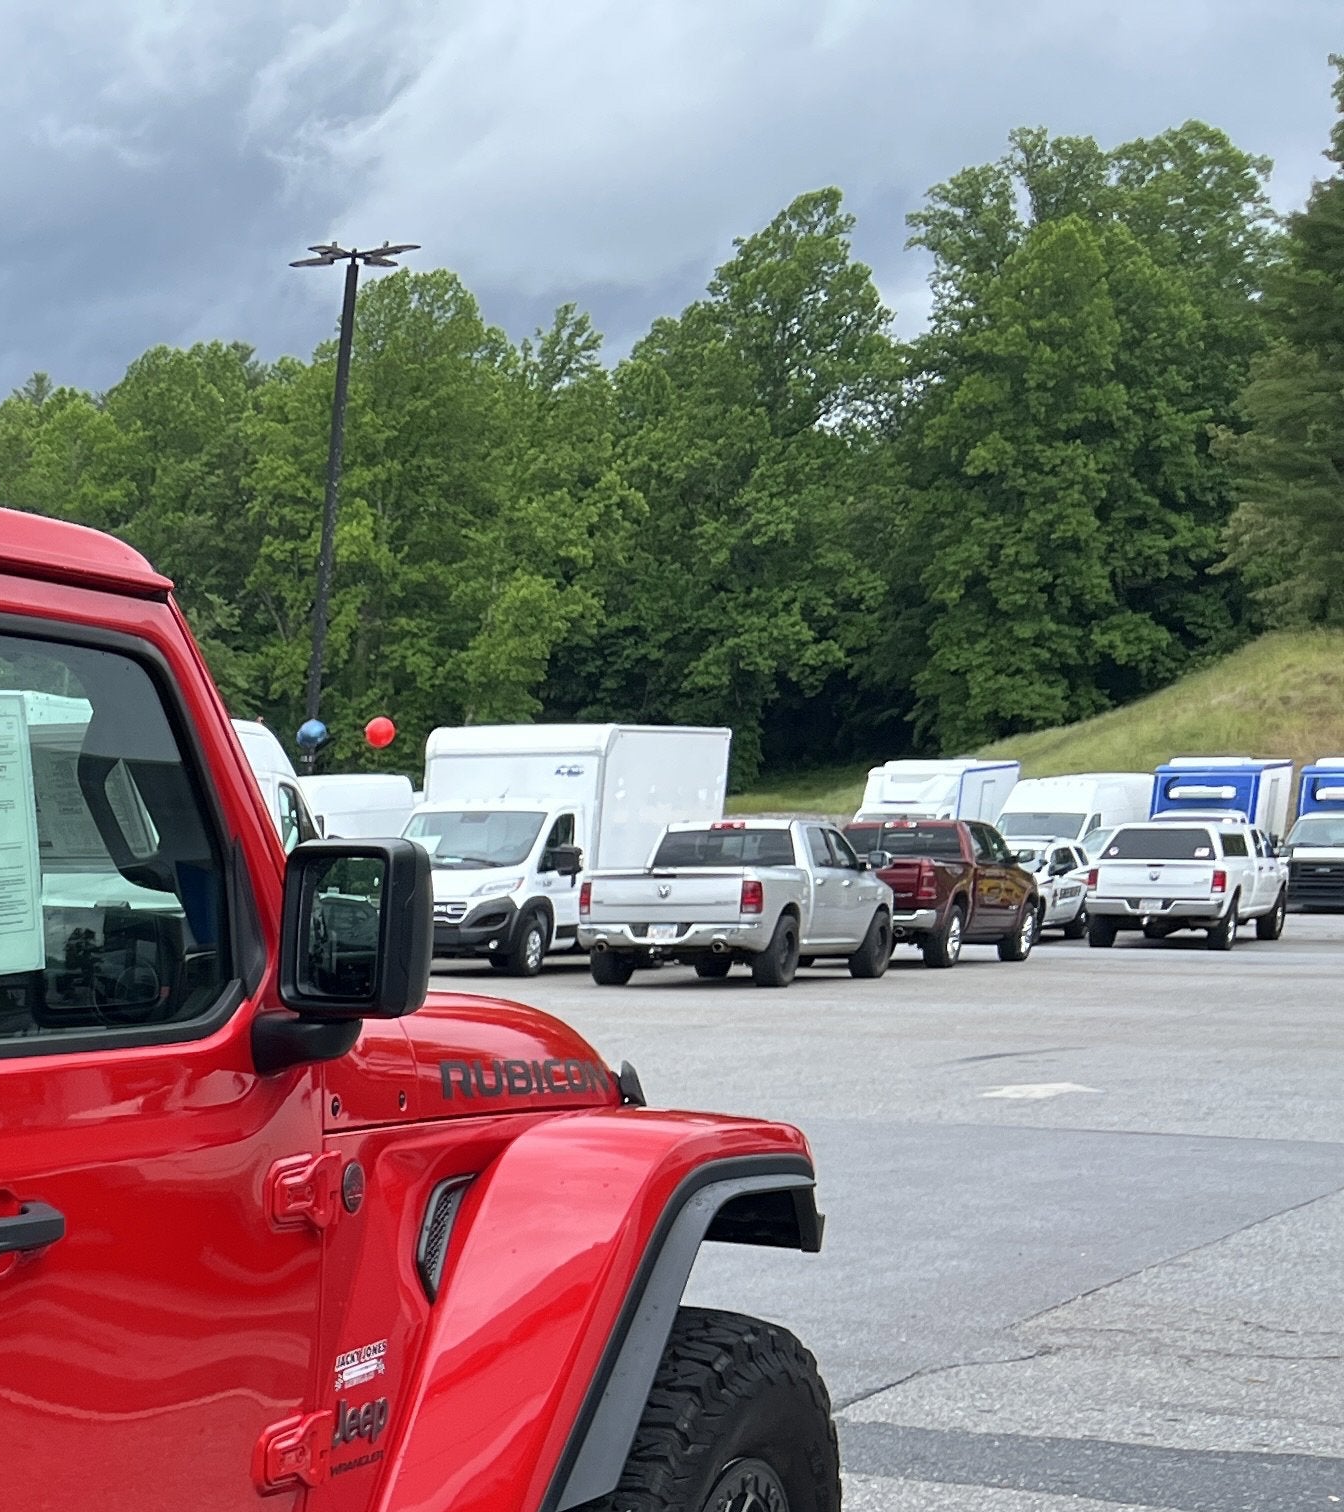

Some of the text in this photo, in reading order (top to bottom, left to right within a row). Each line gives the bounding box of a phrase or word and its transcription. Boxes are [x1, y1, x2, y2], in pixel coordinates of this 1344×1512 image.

[439, 1058, 610, 1100] RUBICON
[361, 1341, 387, 1360] JONES
[332, 1397, 389, 1449] Jeep
[330, 1451, 385, 1478] WRANGLER
